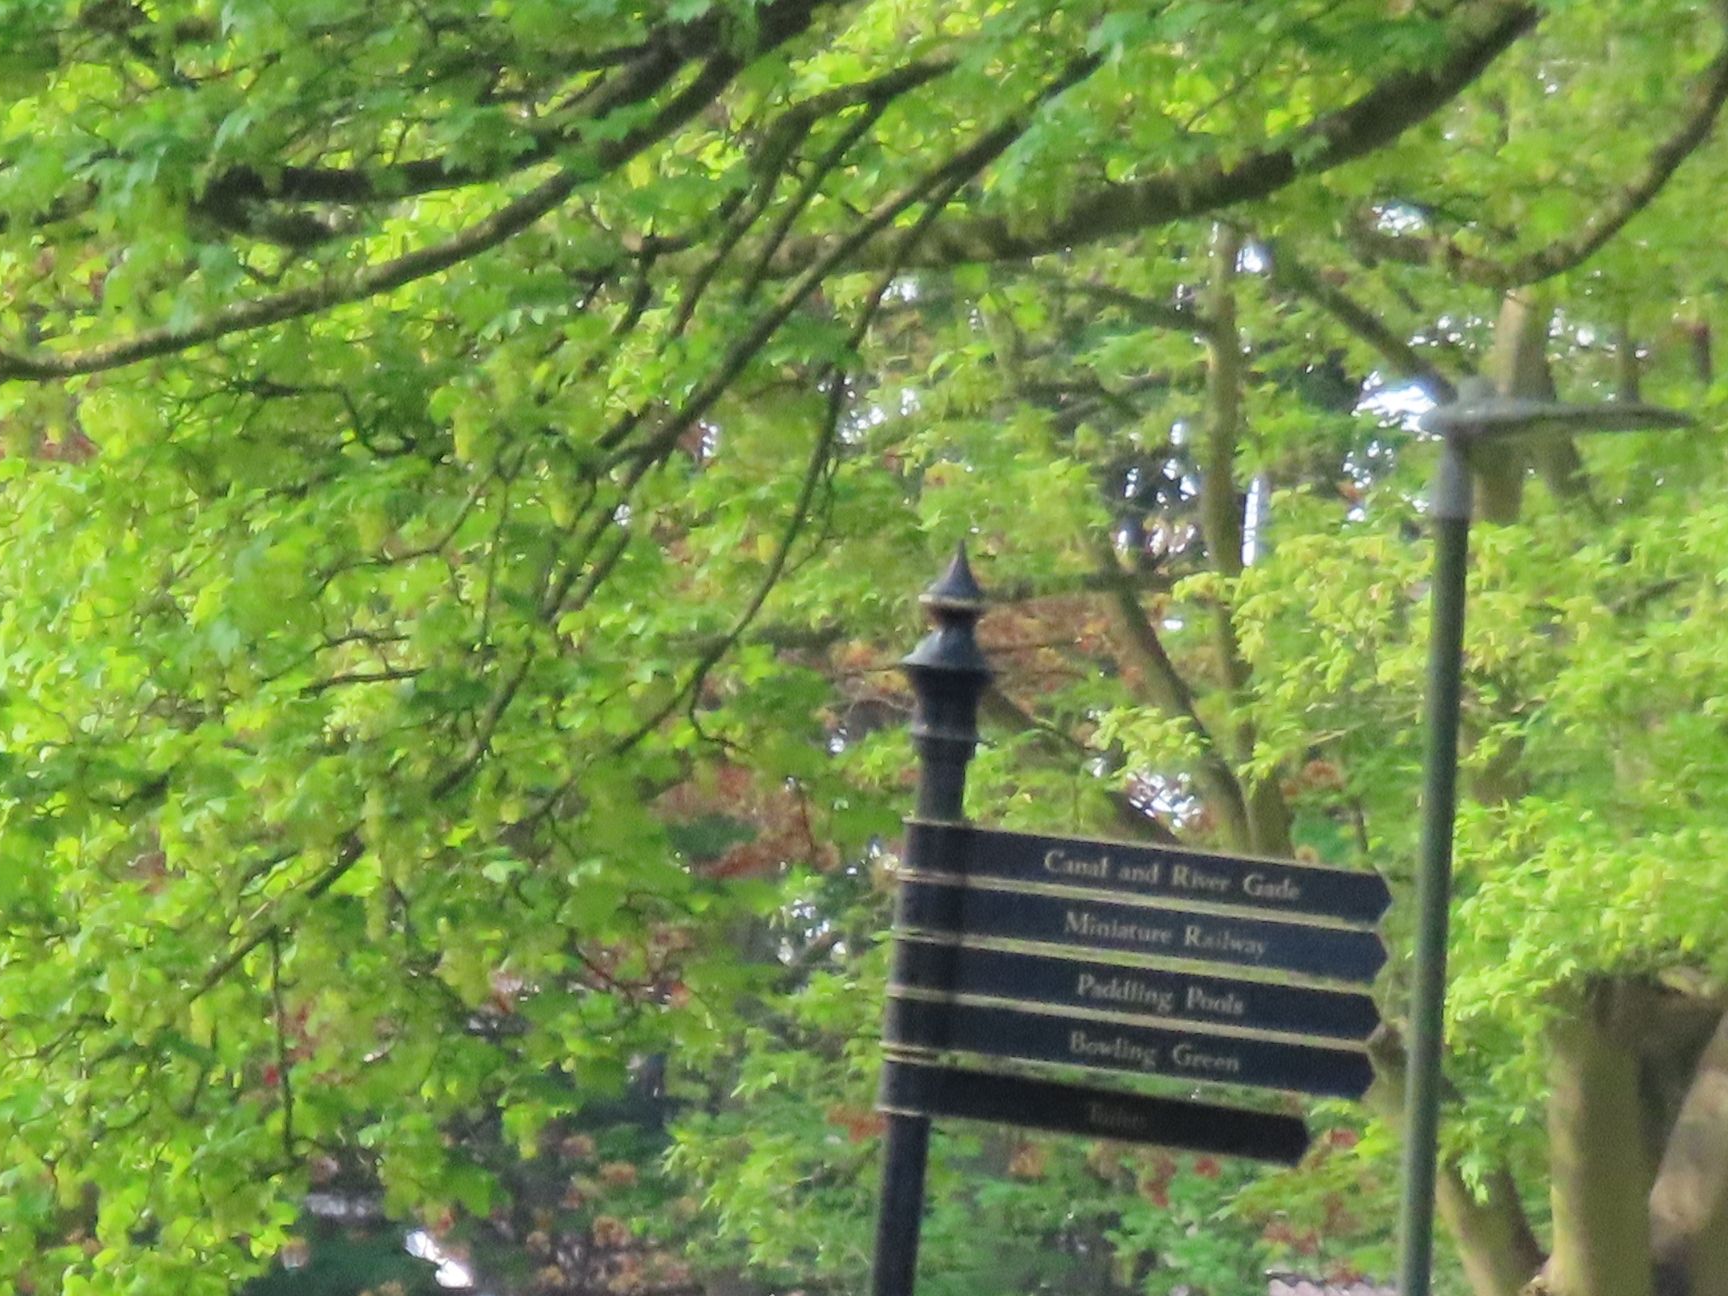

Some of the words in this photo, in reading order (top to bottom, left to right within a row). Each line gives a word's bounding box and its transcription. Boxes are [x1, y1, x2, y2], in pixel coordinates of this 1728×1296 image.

[1044, 849, 1108, 878] Canal
[1118, 861, 1160, 884] and
[1171, 866, 1229, 893] River
[1244, 874, 1301, 901] Gade
[1064, 911, 1173, 943] Miniature
[1183, 926, 1267, 961] Railway
[1077, 974, 1173, 1013] Paddling
[1186, 987, 1244, 1014] Pools
[1070, 1030, 1157, 1070] Bowling
[1172, 1043, 1240, 1072] Green
